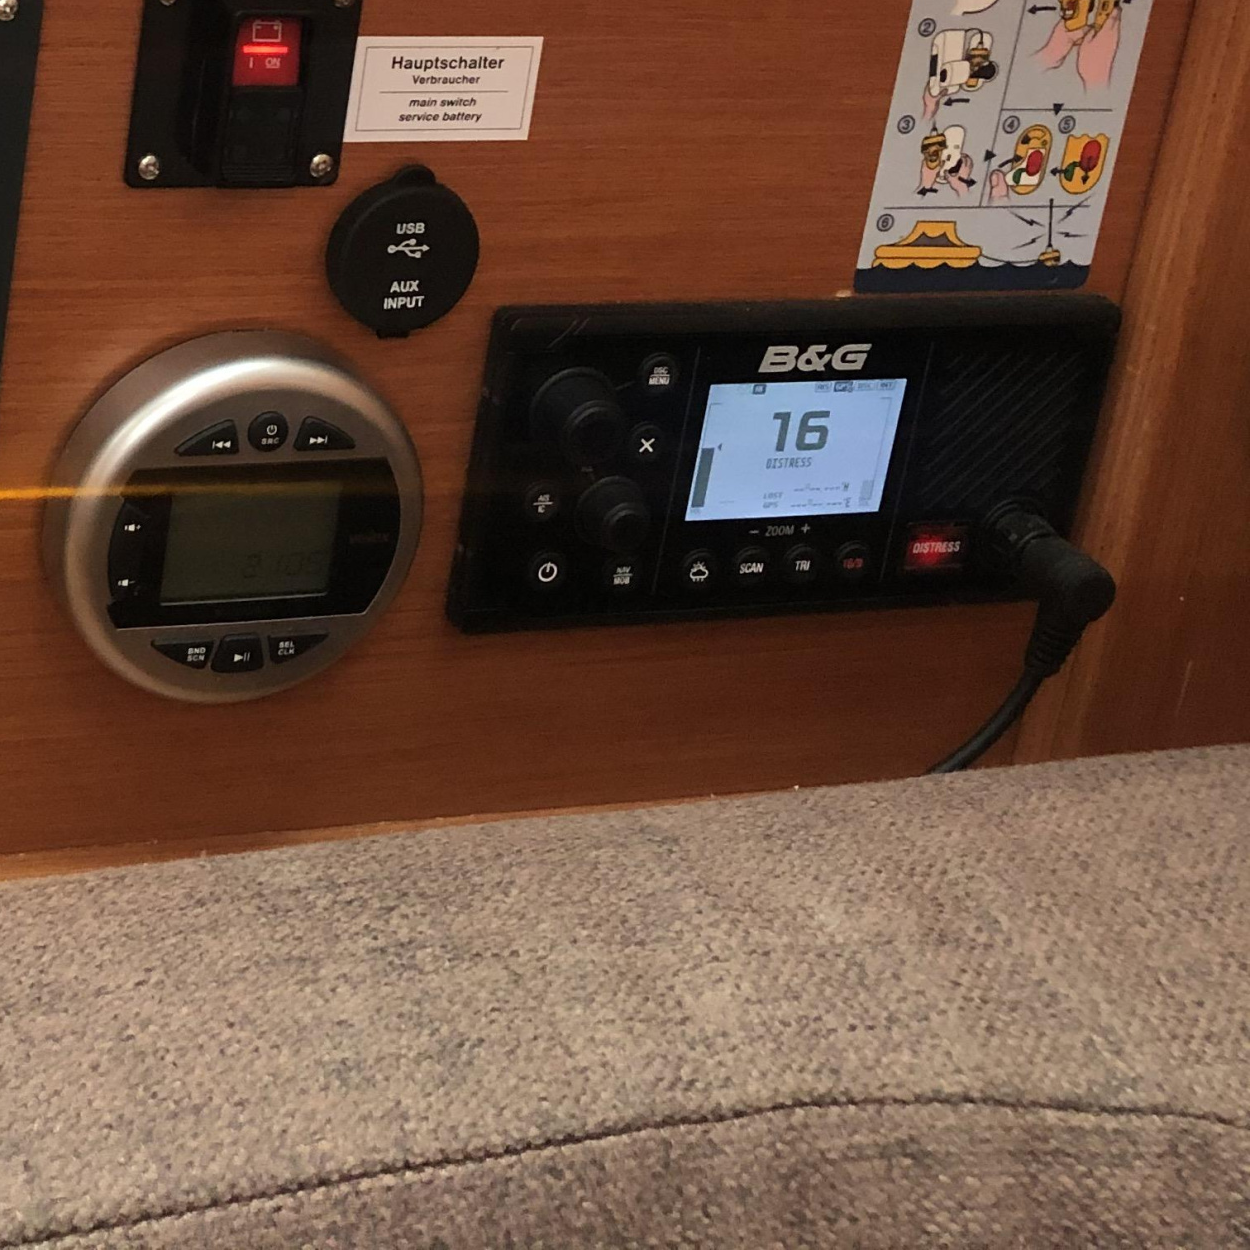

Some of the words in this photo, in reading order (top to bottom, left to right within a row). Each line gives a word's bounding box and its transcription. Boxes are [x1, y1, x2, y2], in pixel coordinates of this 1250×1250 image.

[391, 55, 505, 75] Hauptschalter
[412, 74, 480, 86] Verbraucher
[409, 97, 436, 108] main
[439, 96, 477, 108] switch
[398, 112, 439, 123] service
[442, 110, 483, 124] battery
[396, 222, 425, 235] USB
[390, 279, 420, 293] AUX
[383, 295, 425, 310] INPUT
[758, 343, 873, 373] B&G
[648, 377, 670, 385] MENU
[772, 410, 831, 453] 16
[261, 437, 280, 445] SRC
[765, 456, 813, 470] DISTRESS
[765, 525, 795, 536] ZOOM
[912, 541, 962, 554] DISTRESS
[739, 562, 764, 574] SCAN
[794, 560, 811, 572] TRI
[279, 640, 295, 648] SEL
[188, 646, 206, 655] BND
[277, 648, 295, 656] CLK
[187, 654, 205, 662] SCN
